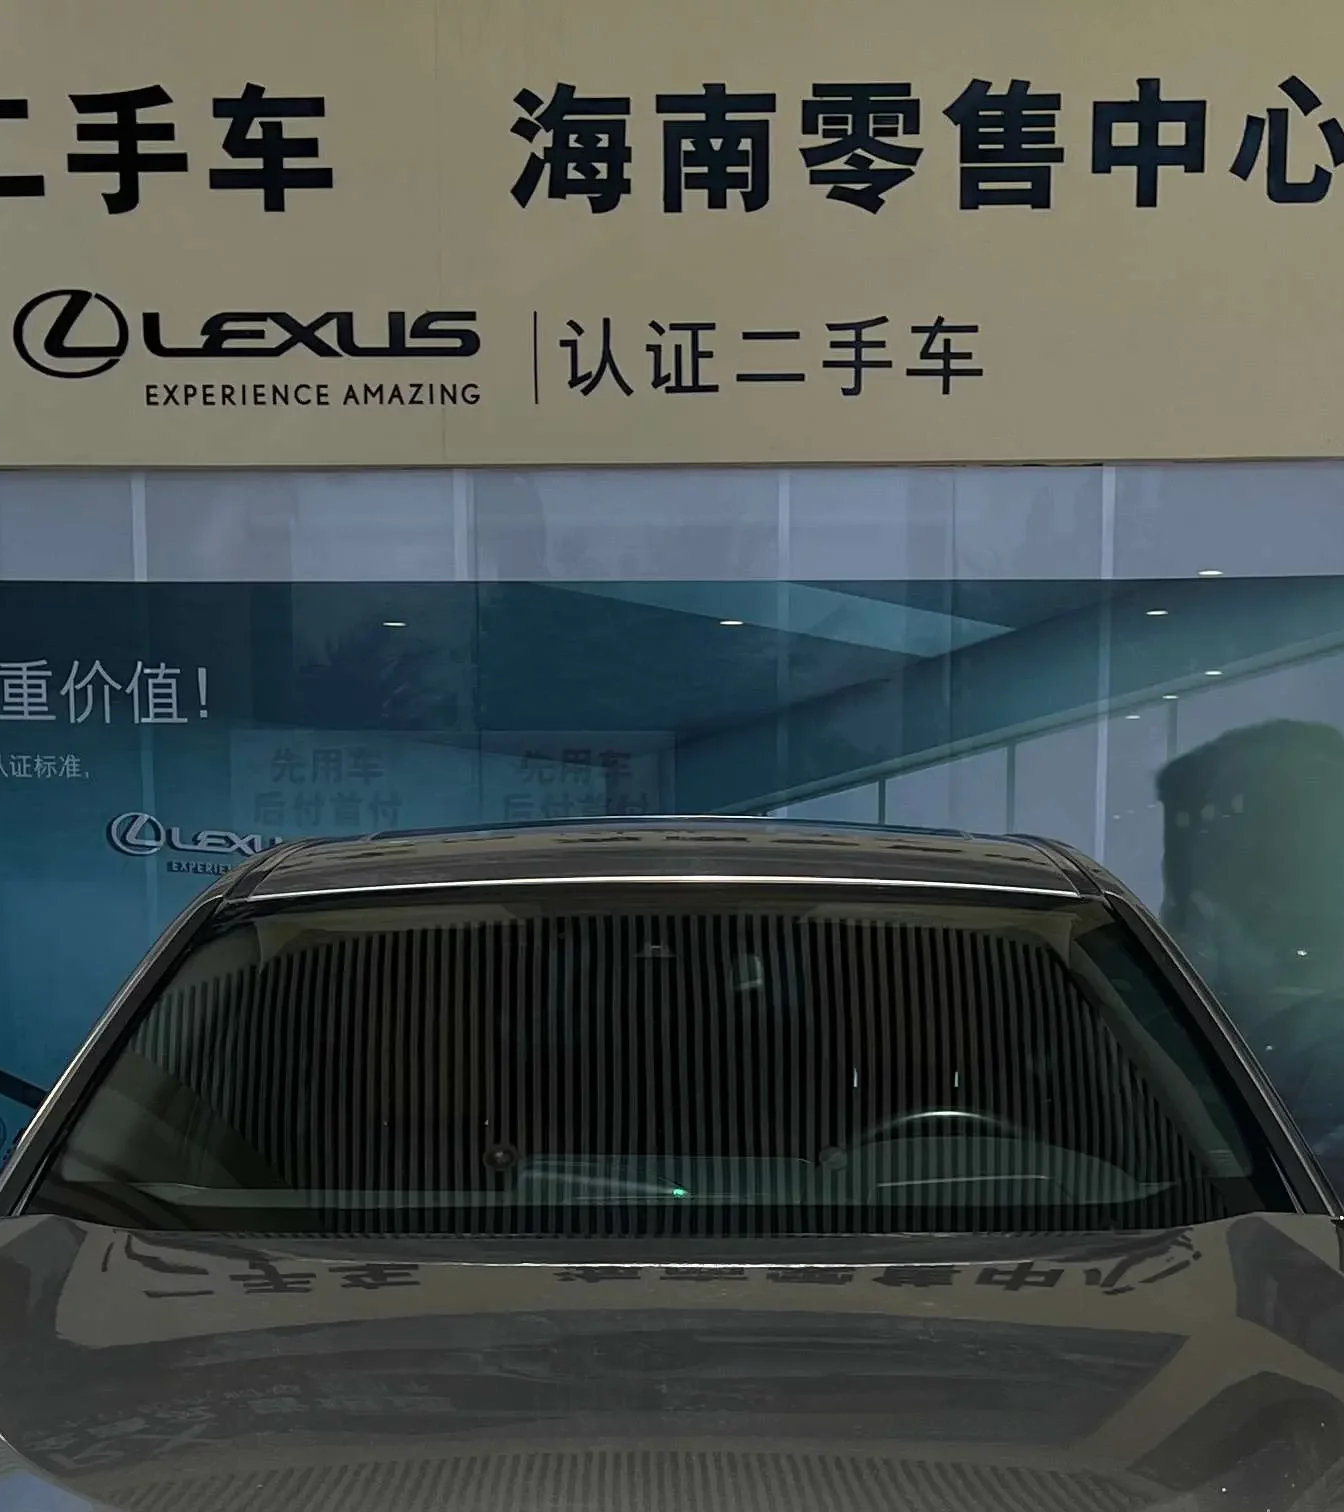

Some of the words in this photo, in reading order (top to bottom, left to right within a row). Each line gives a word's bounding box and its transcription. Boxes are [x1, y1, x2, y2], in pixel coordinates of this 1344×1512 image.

[142, 311, 481, 358] LEXUS
[559, 315, 984, 397] 认证二手车
[145, 383, 329, 406] EXPERIENCE
[343, 383, 481, 406] AMAZING
[170, 826, 284, 857] LEXU
[171, 860, 231, 876] EXPERIE
